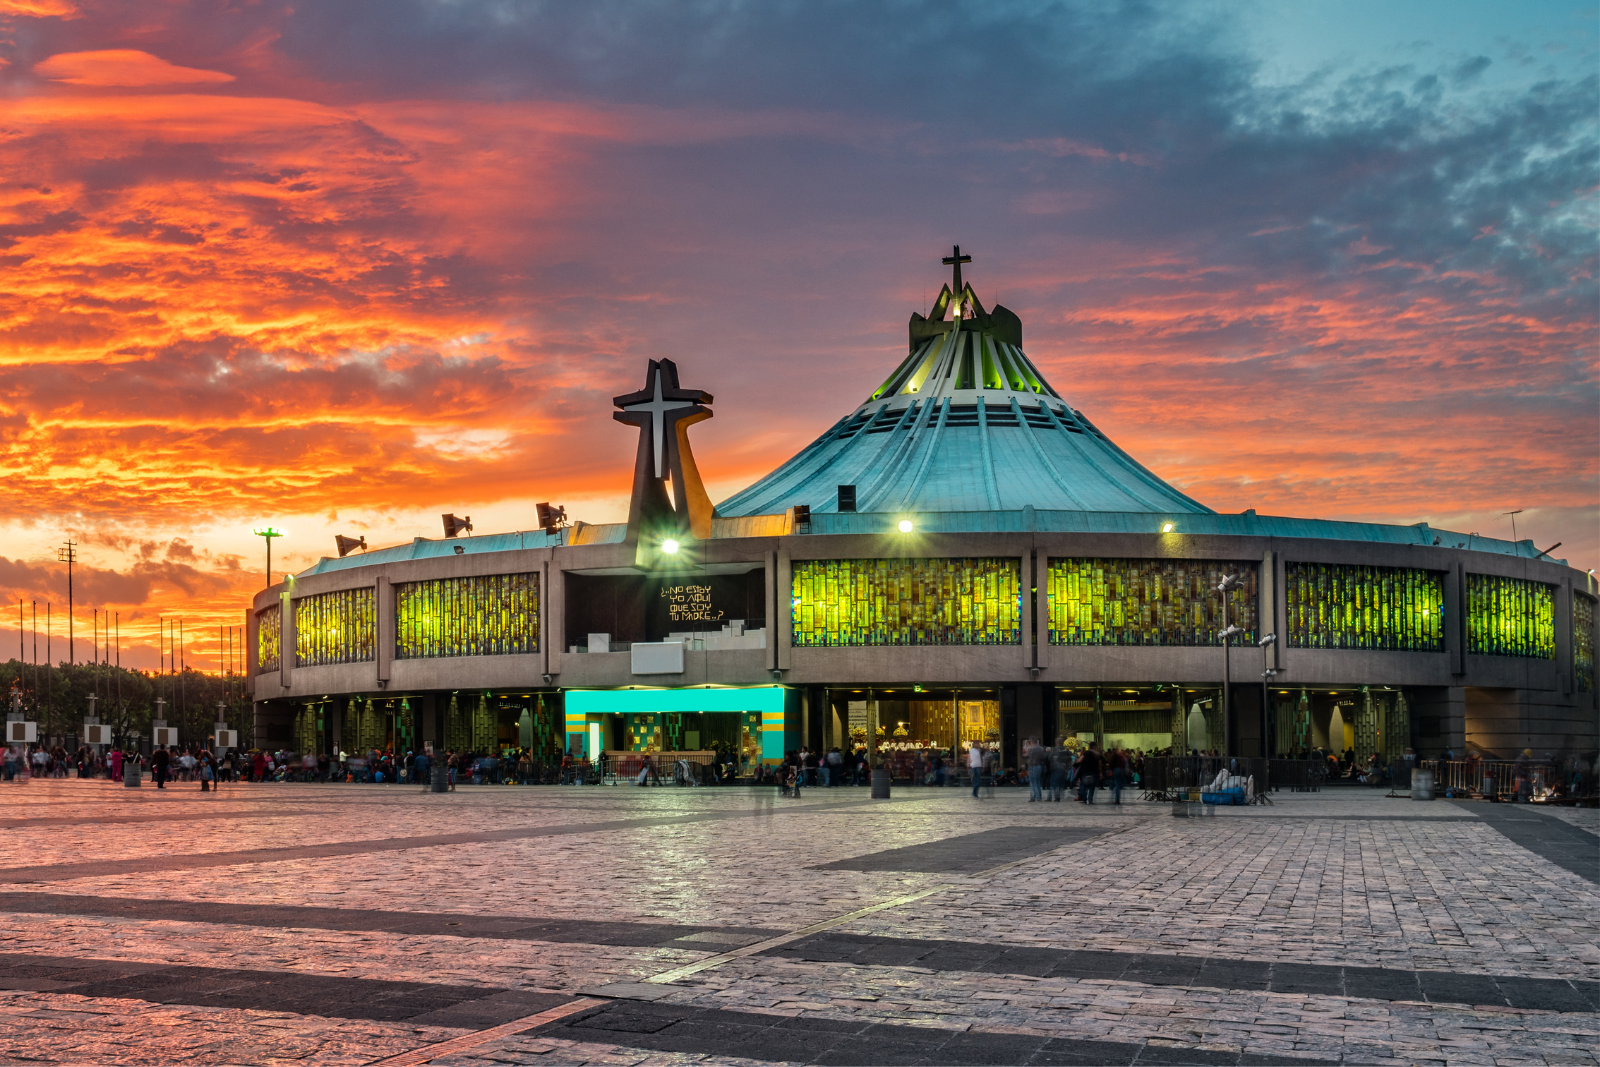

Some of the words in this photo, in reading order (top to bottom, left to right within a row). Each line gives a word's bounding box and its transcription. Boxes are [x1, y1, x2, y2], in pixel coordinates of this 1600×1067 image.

[669, 594, 685, 603] YO
[670, 604, 689, 612] QUE
[691, 603, 711, 611] SOY
[669, 612, 679, 621] TU
